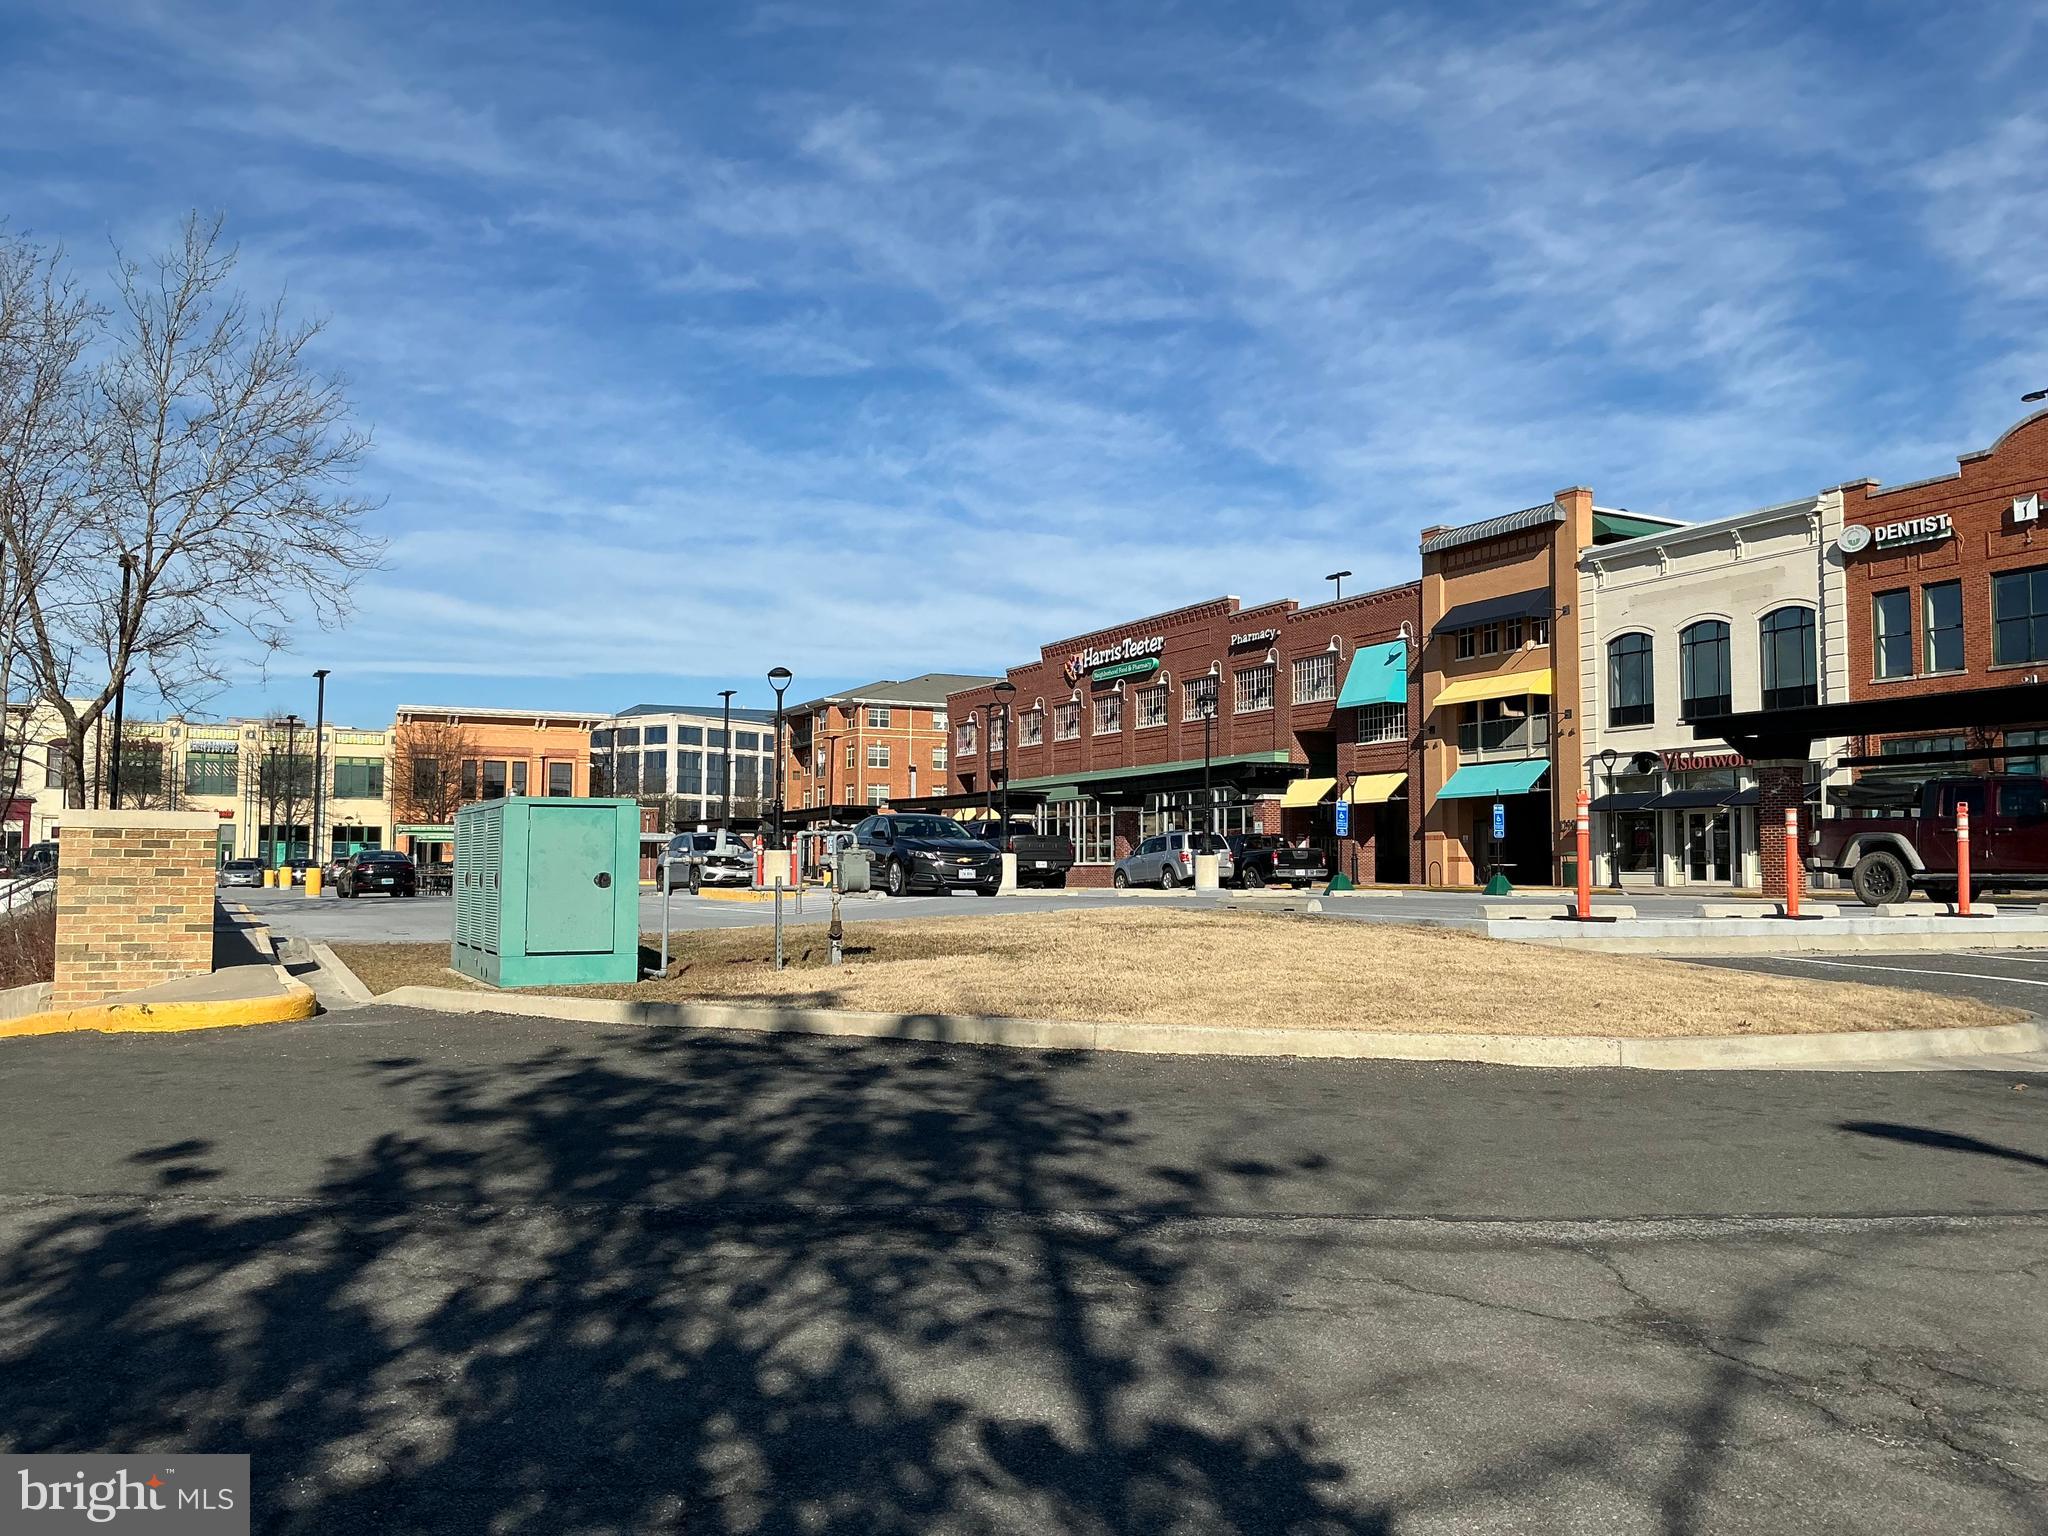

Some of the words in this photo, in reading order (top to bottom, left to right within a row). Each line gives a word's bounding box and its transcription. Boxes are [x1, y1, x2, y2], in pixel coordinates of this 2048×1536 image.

[1875, 513, 1949, 542] DENTIST
[1083, 643, 1122, 668] Harris
[1122, 636, 1164, 659] Teeter
[1231, 629, 1276, 646] Pharmacy
